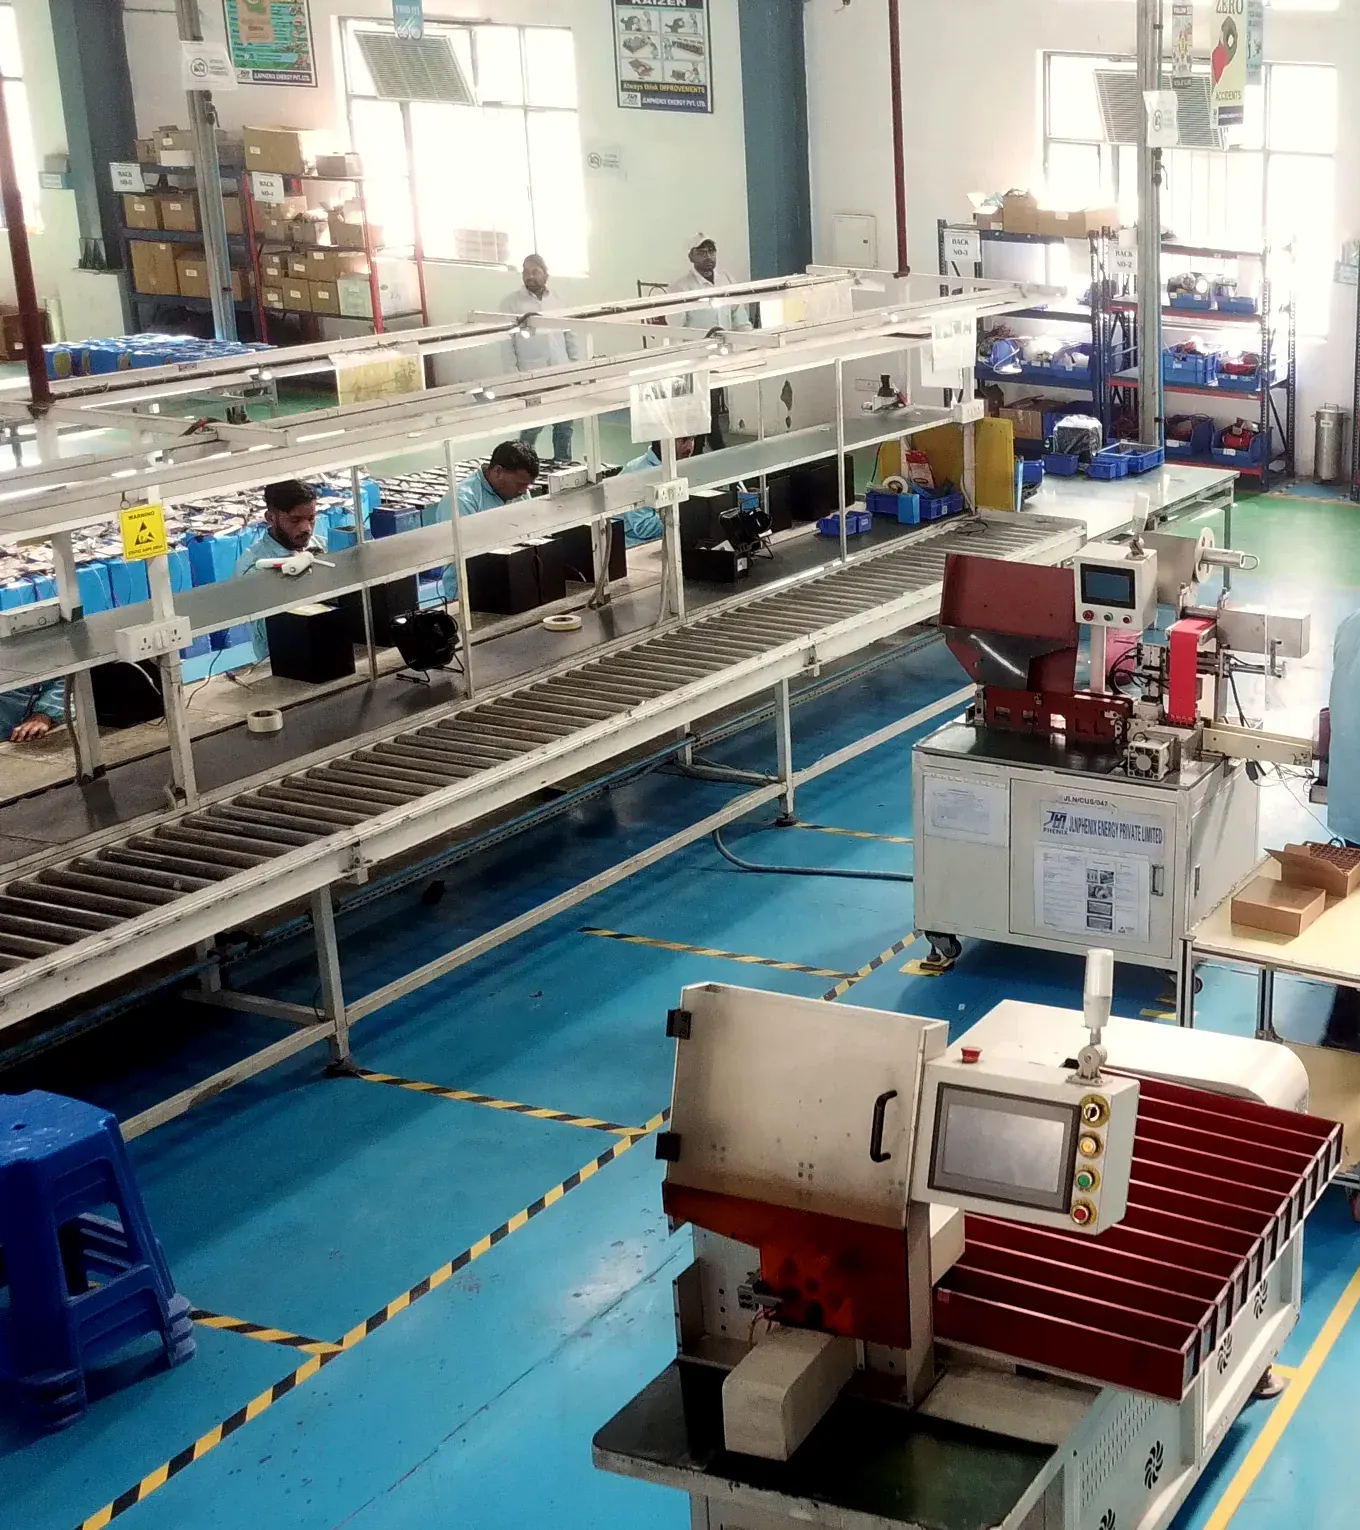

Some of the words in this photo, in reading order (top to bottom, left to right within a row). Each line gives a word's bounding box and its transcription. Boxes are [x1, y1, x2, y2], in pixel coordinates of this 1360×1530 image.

[1216, 0, 1244, 14] ZERO
[623, 82, 643, 91] Always
[643, 83, 659, 91] think
[659, 84, 705, 93] IMPROVEMENTS
[1215, 91, 1242, 101] ACCIDENTS
[951, 238, 969, 246] RACK
[1115, 250, 1133, 258] RACK
[128, 511, 155, 520] WARNING
[1043, 827, 1068, 836] PHENIX
[1068, 816, 1098, 836] JLNPHENIX
[1097, 820, 1119, 839] ENERGY
[1119, 822, 1142, 842] PRIVATE
[1141, 825, 1163, 845] LIMITED
